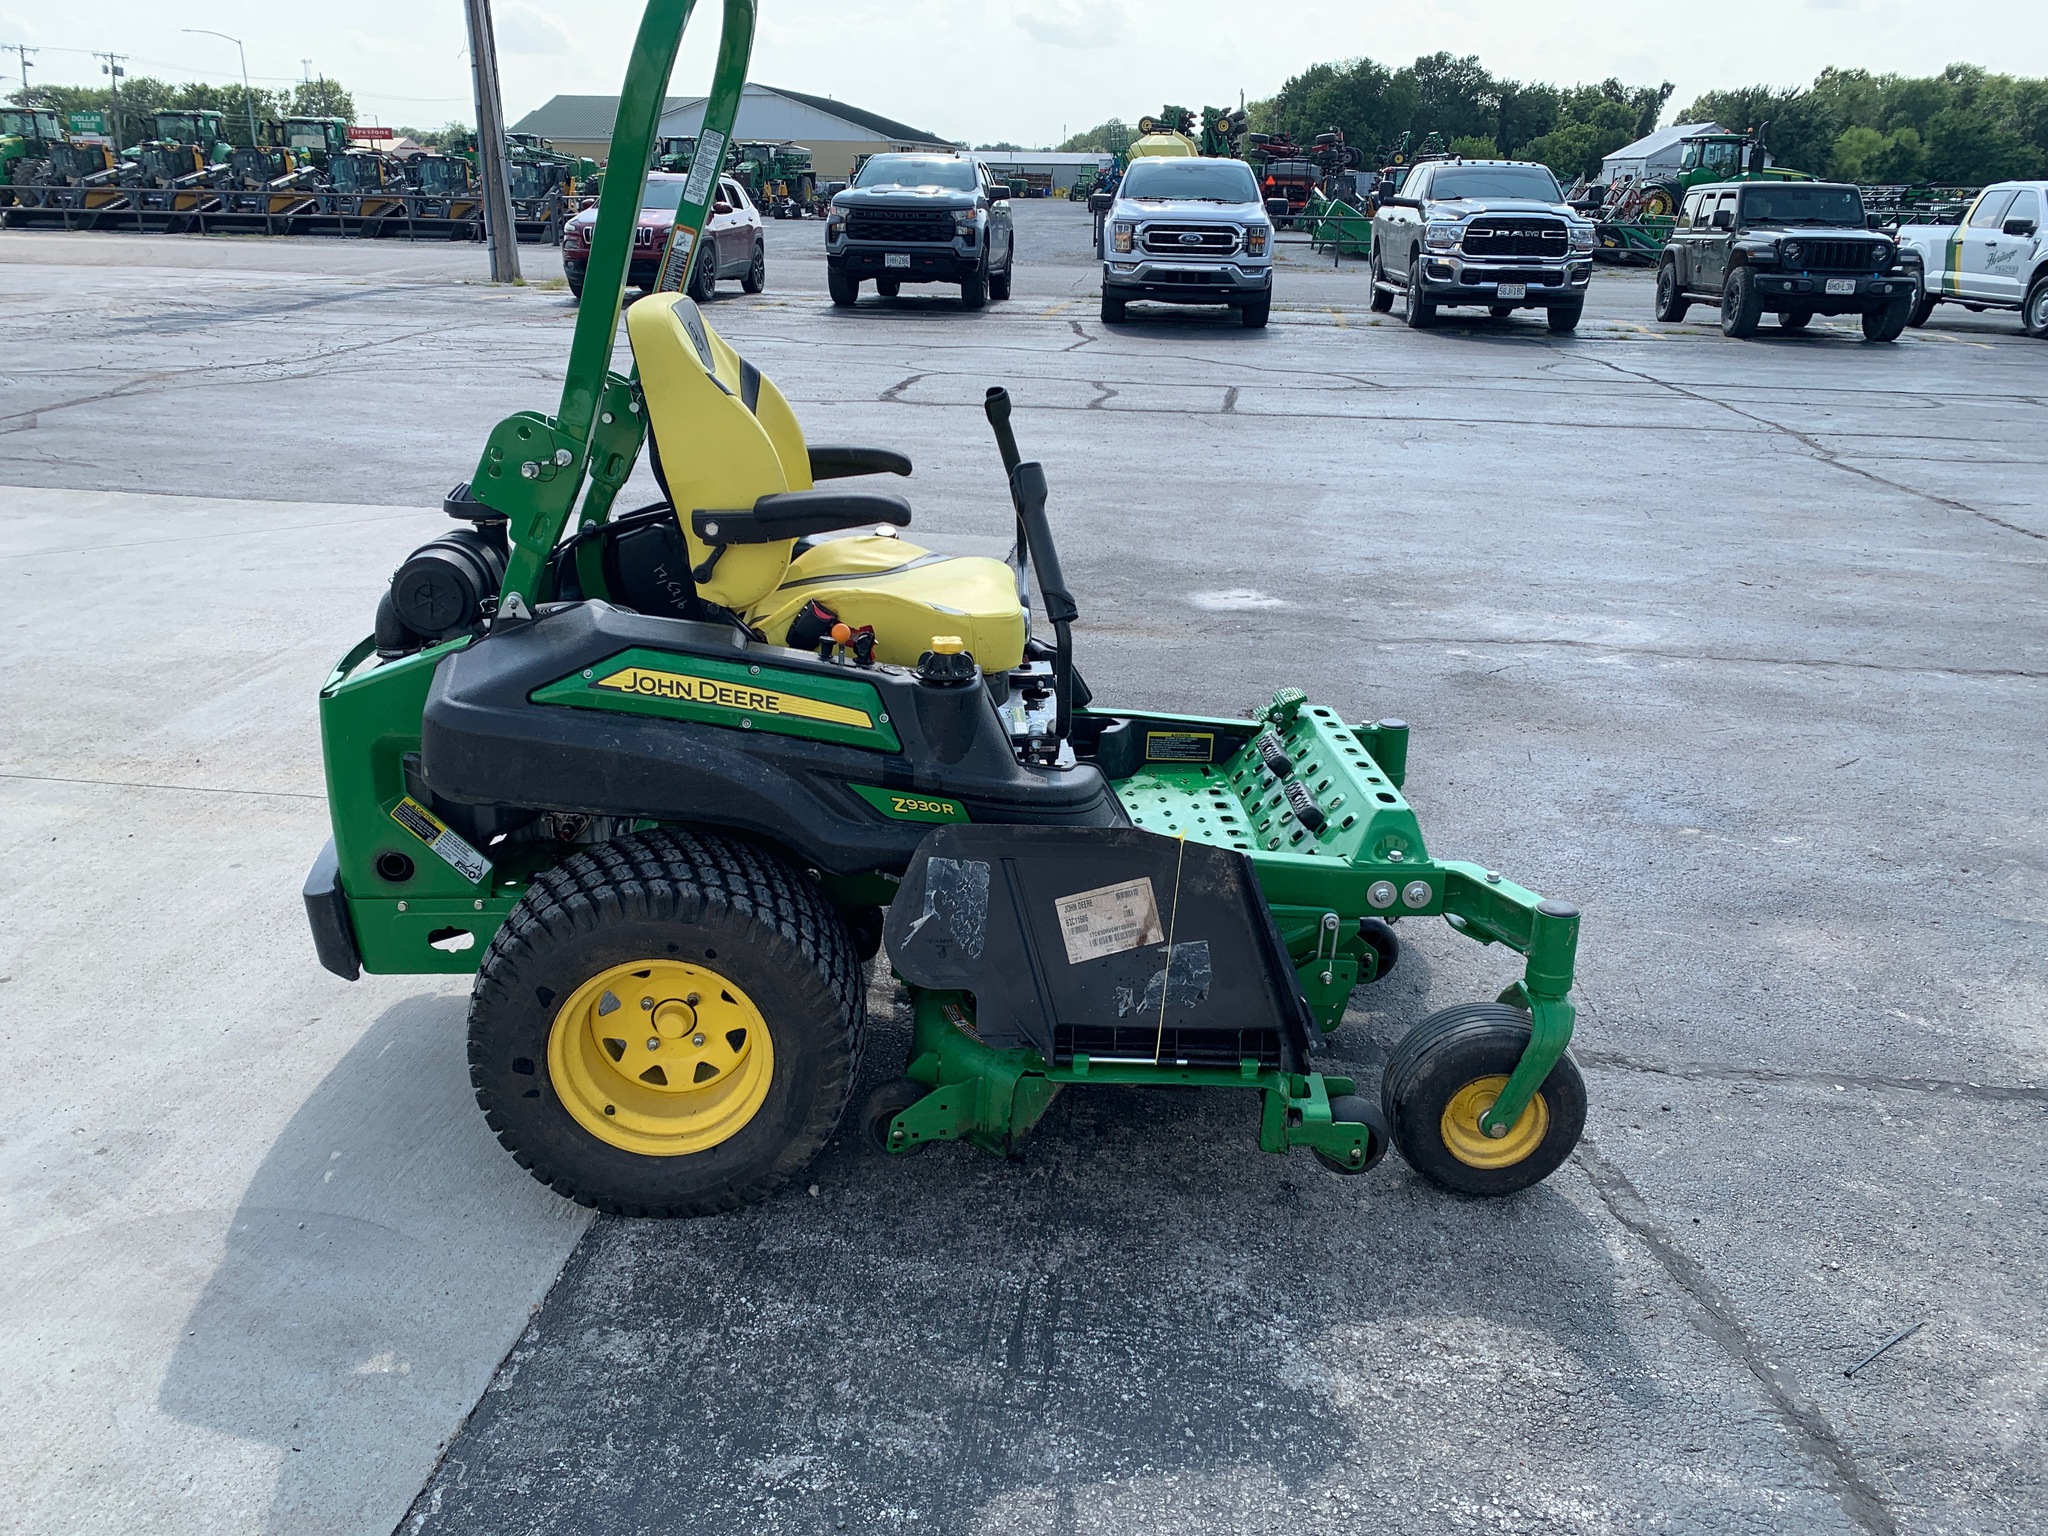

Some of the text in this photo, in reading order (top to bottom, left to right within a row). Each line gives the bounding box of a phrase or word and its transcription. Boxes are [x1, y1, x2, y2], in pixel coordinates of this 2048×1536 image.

[853, 210, 944, 219] CHEVROLET
[1994, 265, 2020, 274] TRACTOR
[624, 671, 780, 711] JOHN DEERE
[890, 796, 956, 815] Z930R
[416, 806, 438, 825] CAUTION
[1064, 899, 1094, 913] JOHN DEERE
